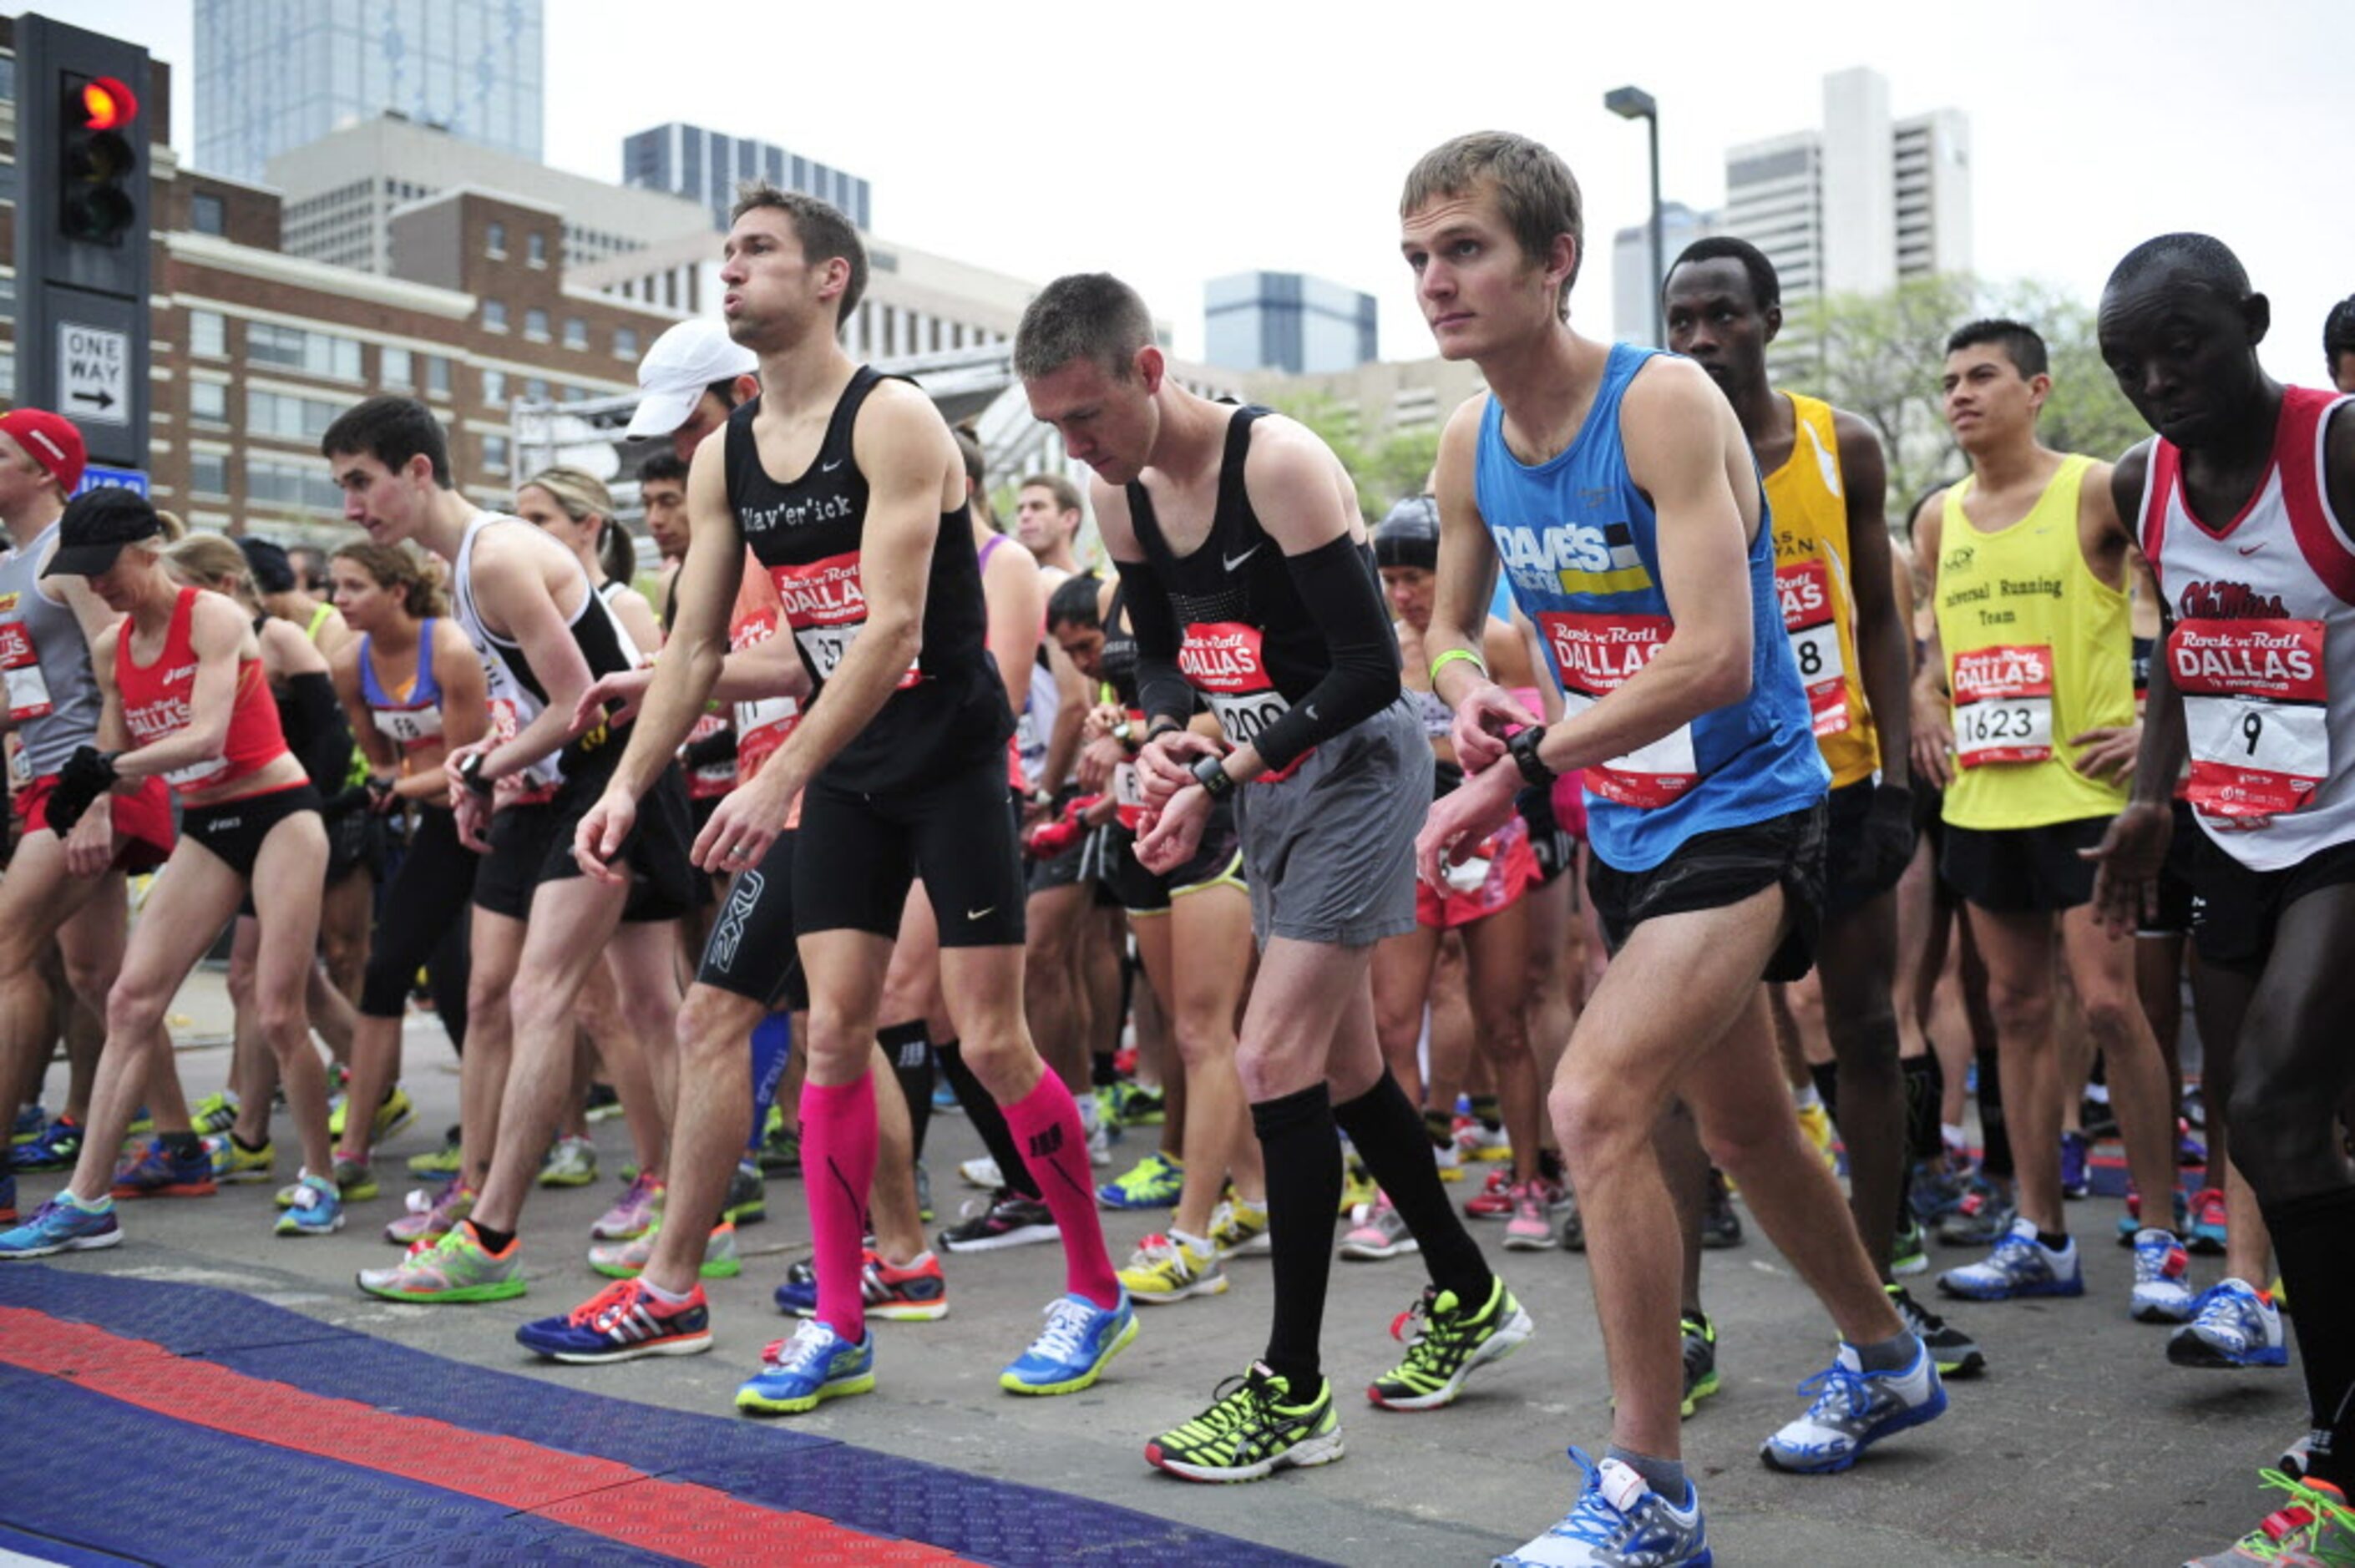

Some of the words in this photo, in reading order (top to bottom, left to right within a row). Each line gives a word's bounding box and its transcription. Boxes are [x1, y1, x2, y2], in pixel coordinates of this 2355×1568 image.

[69, 333, 119, 362] ONE
[69, 360, 119, 383] WAY
[1492, 522, 1611, 573] DAVE'S
[781, 579, 865, 615] DALLA
[2000, 576, 2062, 599] Running
[1979, 610, 2016, 626] Team
[2182, 631, 2235, 648] Rock
[2251, 631, 2302, 649] Roll
[1179, 647, 1257, 676] DALLAS
[1798, 640, 1822, 675] 8
[2175, 648, 2314, 680] DALLAS
[1954, 661, 2045, 691] DALLAS
[1965, 708, 2032, 742] 1623
[2243, 712, 2261, 756] 9
